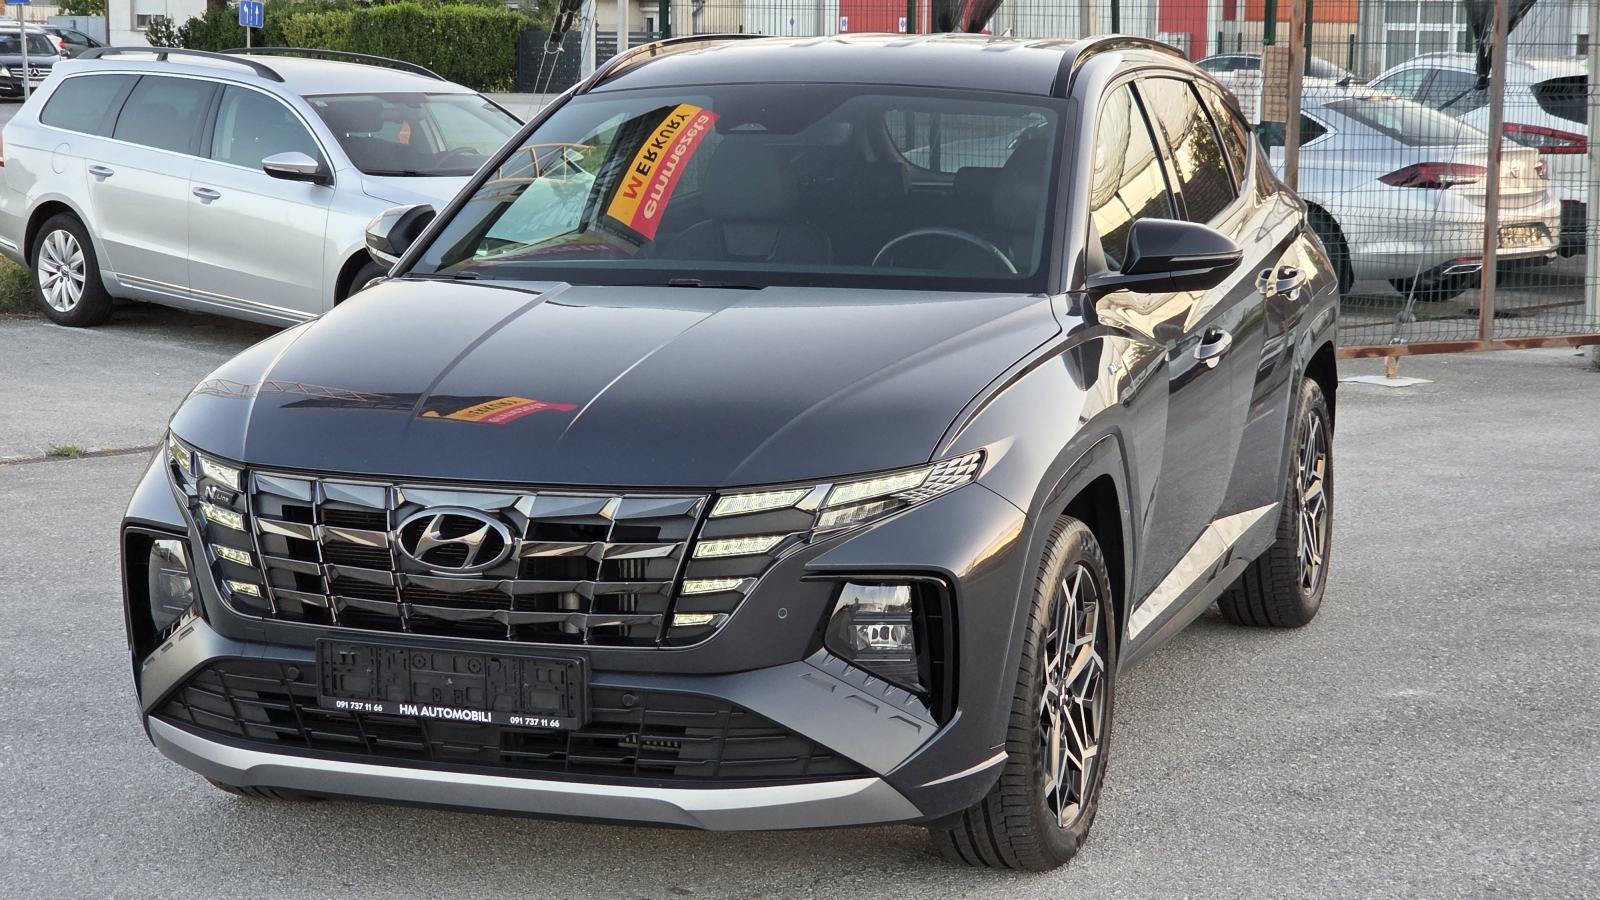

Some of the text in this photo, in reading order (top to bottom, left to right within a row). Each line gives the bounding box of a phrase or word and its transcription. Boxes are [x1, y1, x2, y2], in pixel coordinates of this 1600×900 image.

[336, 700, 560, 728] 091 737 11 66 HM AUTOMOBILI 091 737 11 66
